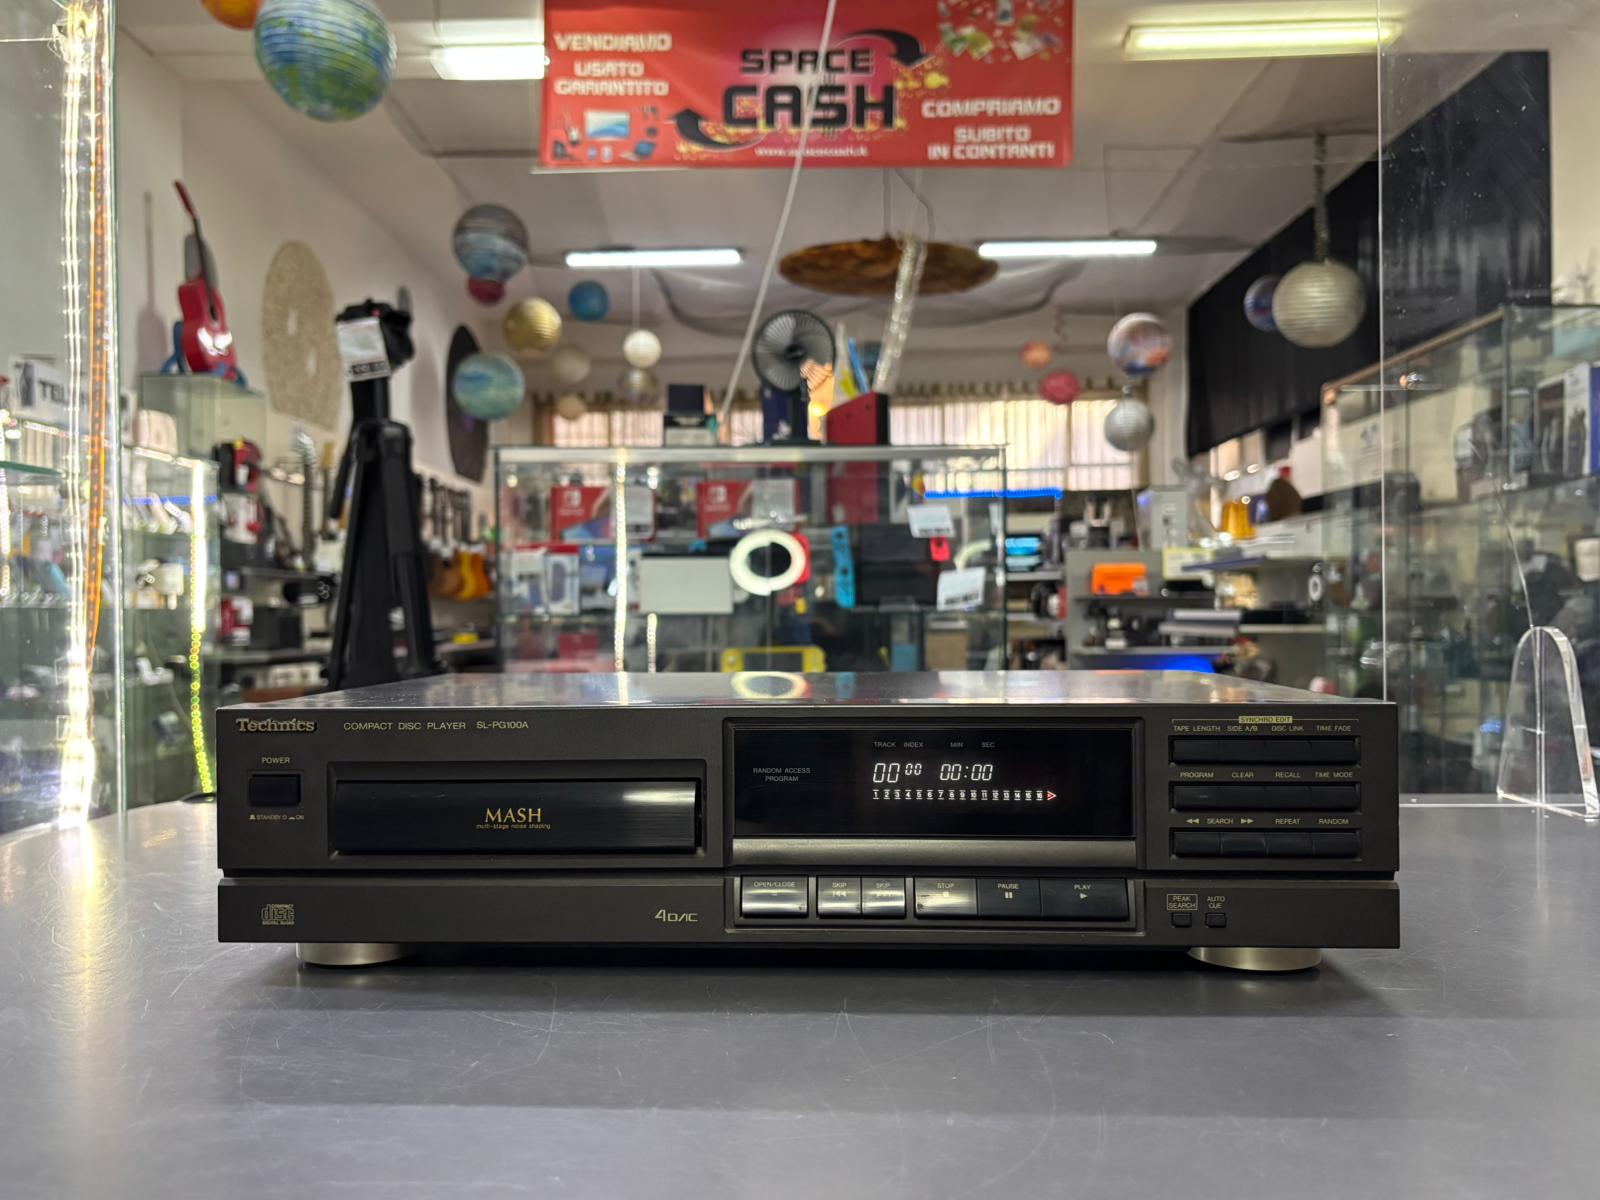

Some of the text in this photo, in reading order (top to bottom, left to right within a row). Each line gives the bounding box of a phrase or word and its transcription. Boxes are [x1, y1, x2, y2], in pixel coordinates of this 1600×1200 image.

[553, 32, 672, 52] VENDIAMO
[574, 60, 645, 77] USATO
[741, 49, 872, 73] SPACE
[553, 79, 669, 96] GARANTITO
[723, 85, 896, 129] CASH
[921, 97, 1062, 118] COMPRIAMO
[954, 125, 1031, 144] SUBITO
[927, 141, 1055, 160] IN CONTANTI
[235, 717, 316, 732] Technics
[343, 720, 530, 731] COMPACT DISC PLAYER SL-PG100A
[873, 763, 900, 783] 00
[905, 763, 922, 776] 00
[940, 764, 994, 781] 00:00
[485, 807, 542, 823] MASH
[261, 903, 295, 921] disc
